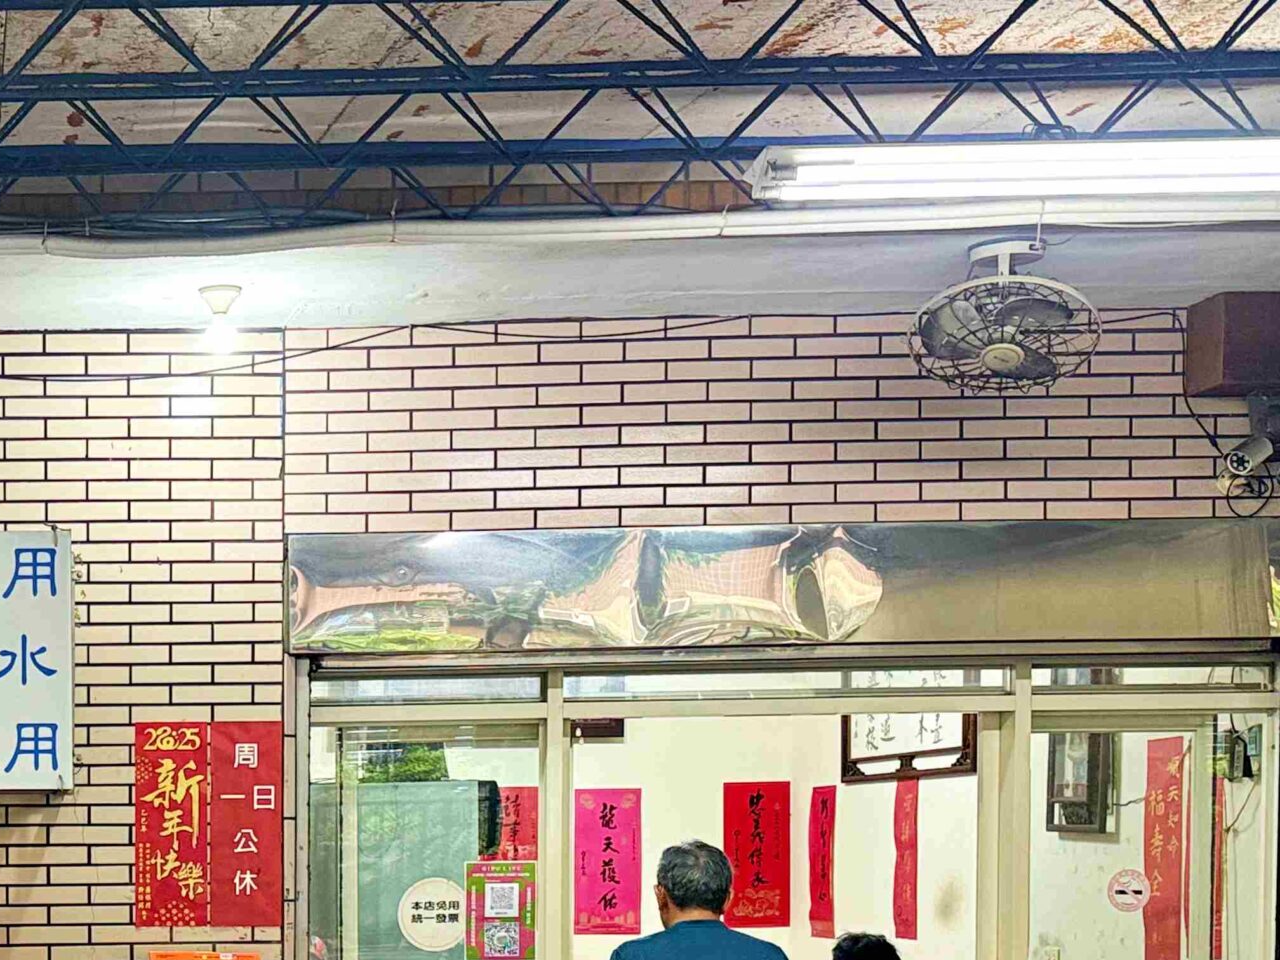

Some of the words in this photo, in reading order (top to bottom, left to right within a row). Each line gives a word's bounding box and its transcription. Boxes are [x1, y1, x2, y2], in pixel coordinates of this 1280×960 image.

[411, 900, 460, 911] 本店免用
[411, 913, 460, 923] 統一發票
